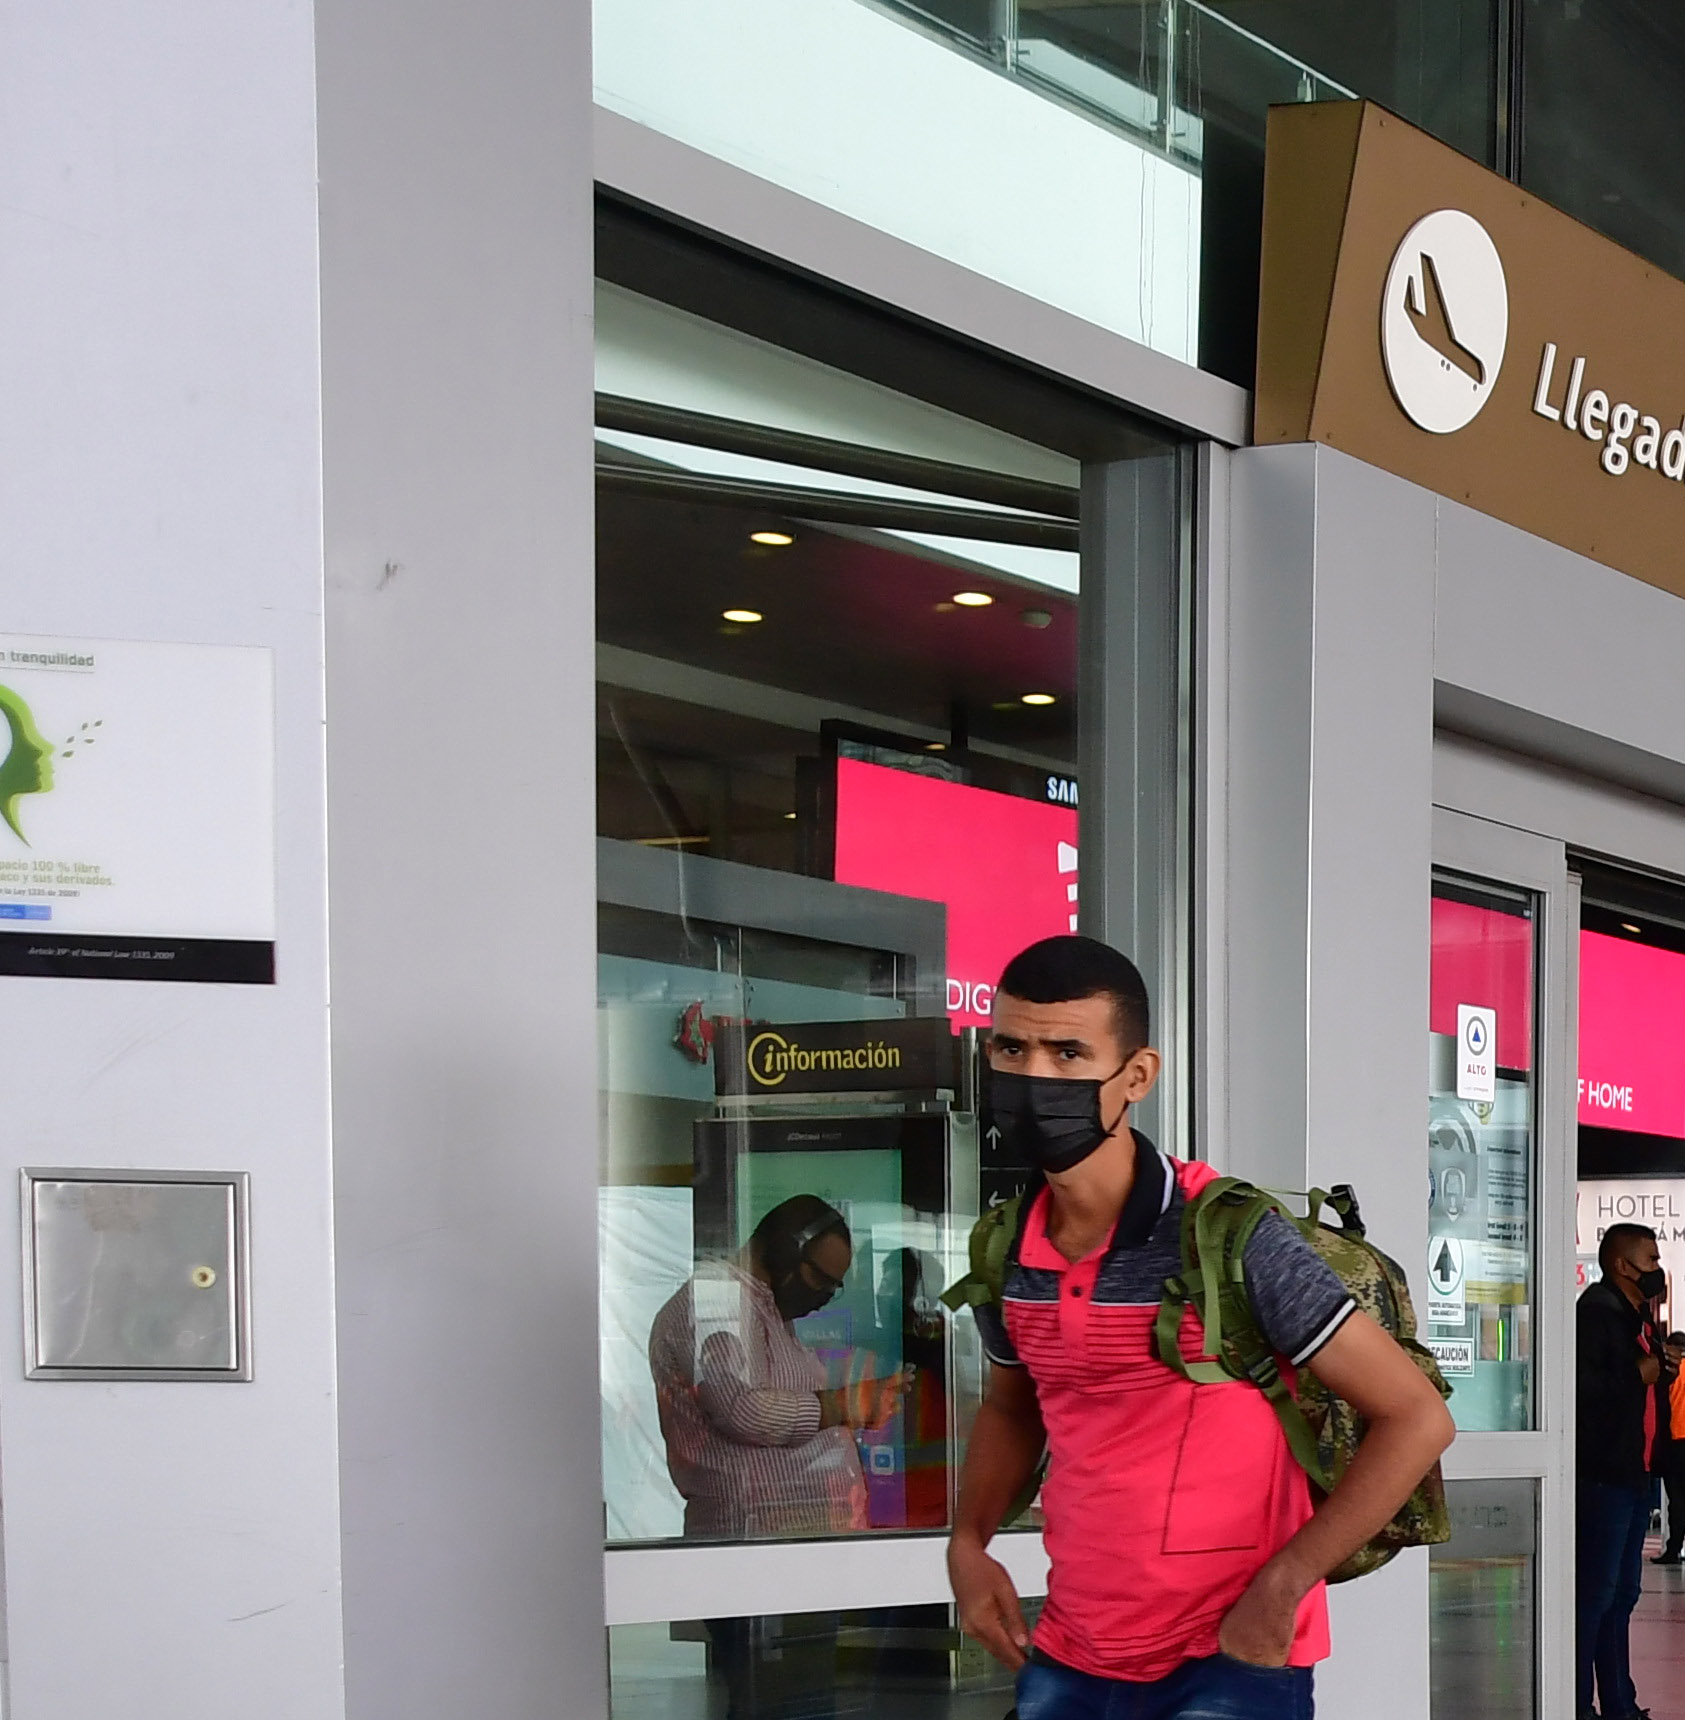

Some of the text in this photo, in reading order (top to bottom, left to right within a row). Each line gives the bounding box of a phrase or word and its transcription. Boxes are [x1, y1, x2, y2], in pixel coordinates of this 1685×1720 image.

[10, 650, 95, 666] tranquilidad
[32, 861, 54, 871] 100
[1466, 1063, 1487, 1076] ALTO
[1588, 1080, 1633, 1112] HOME
[1598, 1194, 1680, 1219] HOTEL
